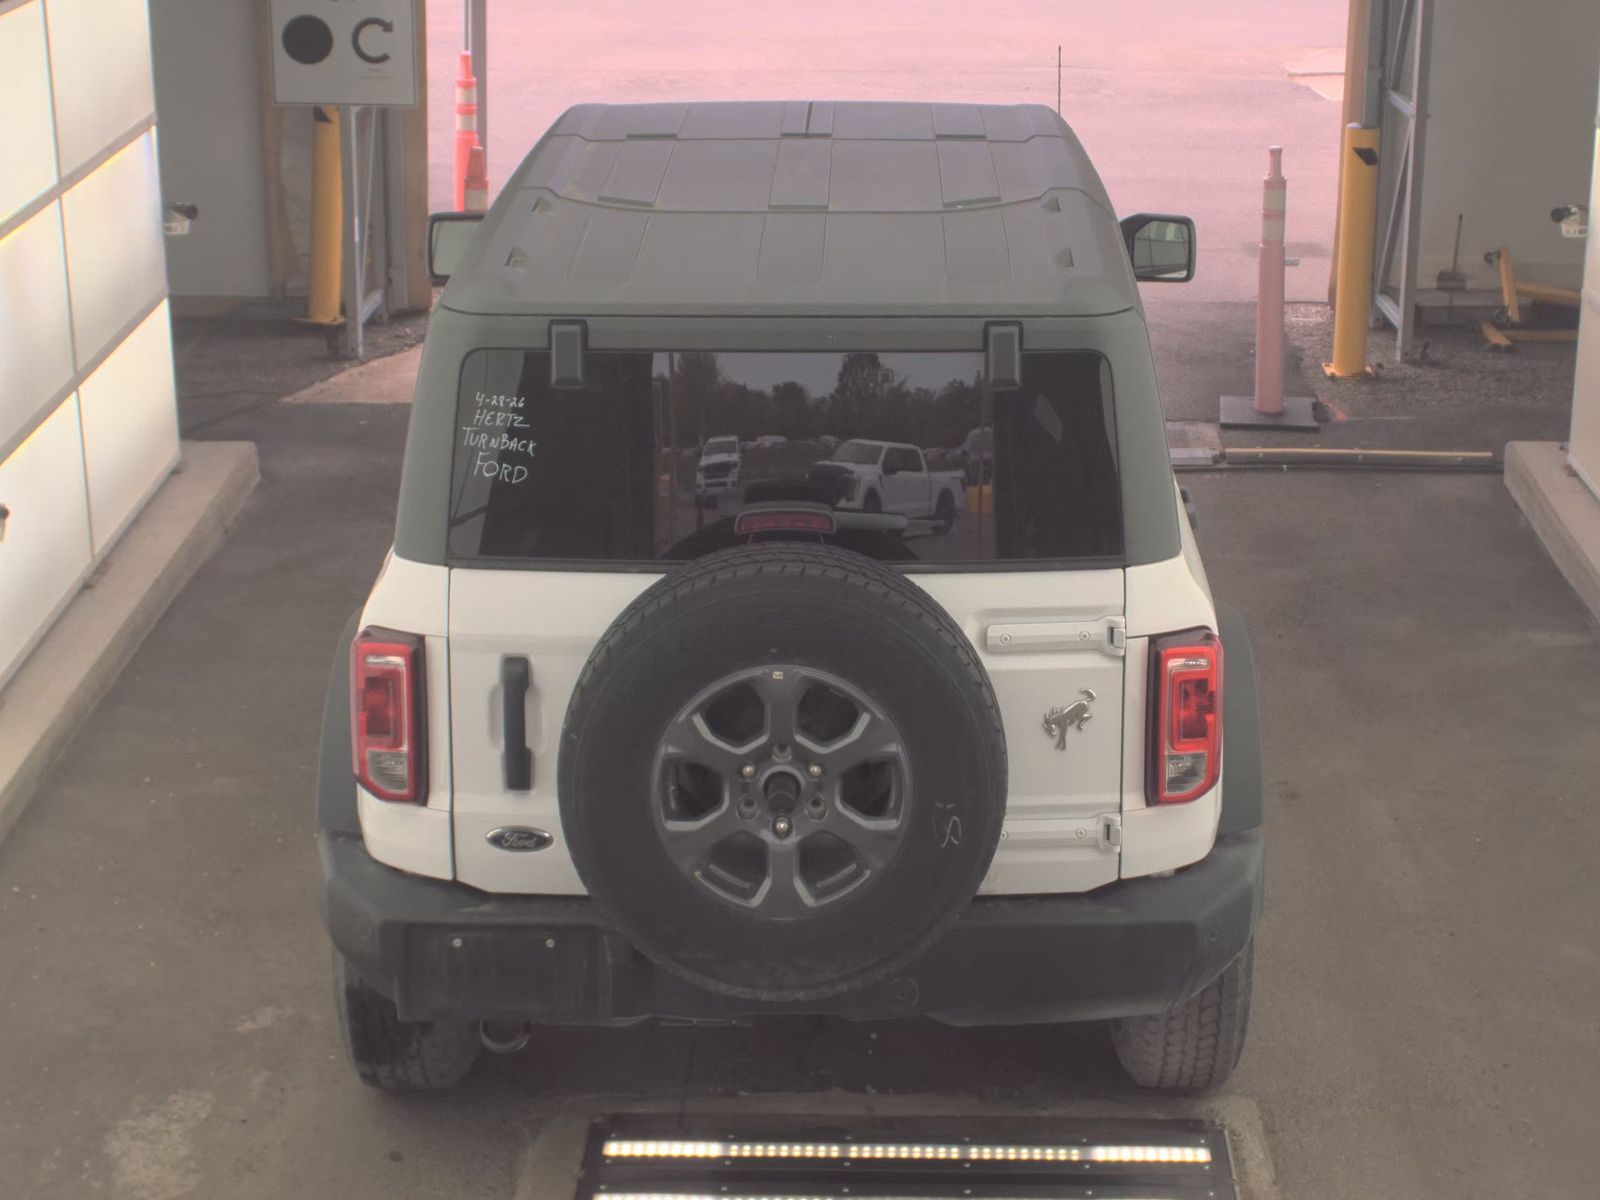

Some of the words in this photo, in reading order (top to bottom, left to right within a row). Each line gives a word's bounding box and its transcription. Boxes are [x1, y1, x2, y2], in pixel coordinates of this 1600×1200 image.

[473, 409, 530, 427] HERTZ
[474, 452, 528, 484] FORD
[502, 832, 538, 848] Ford
